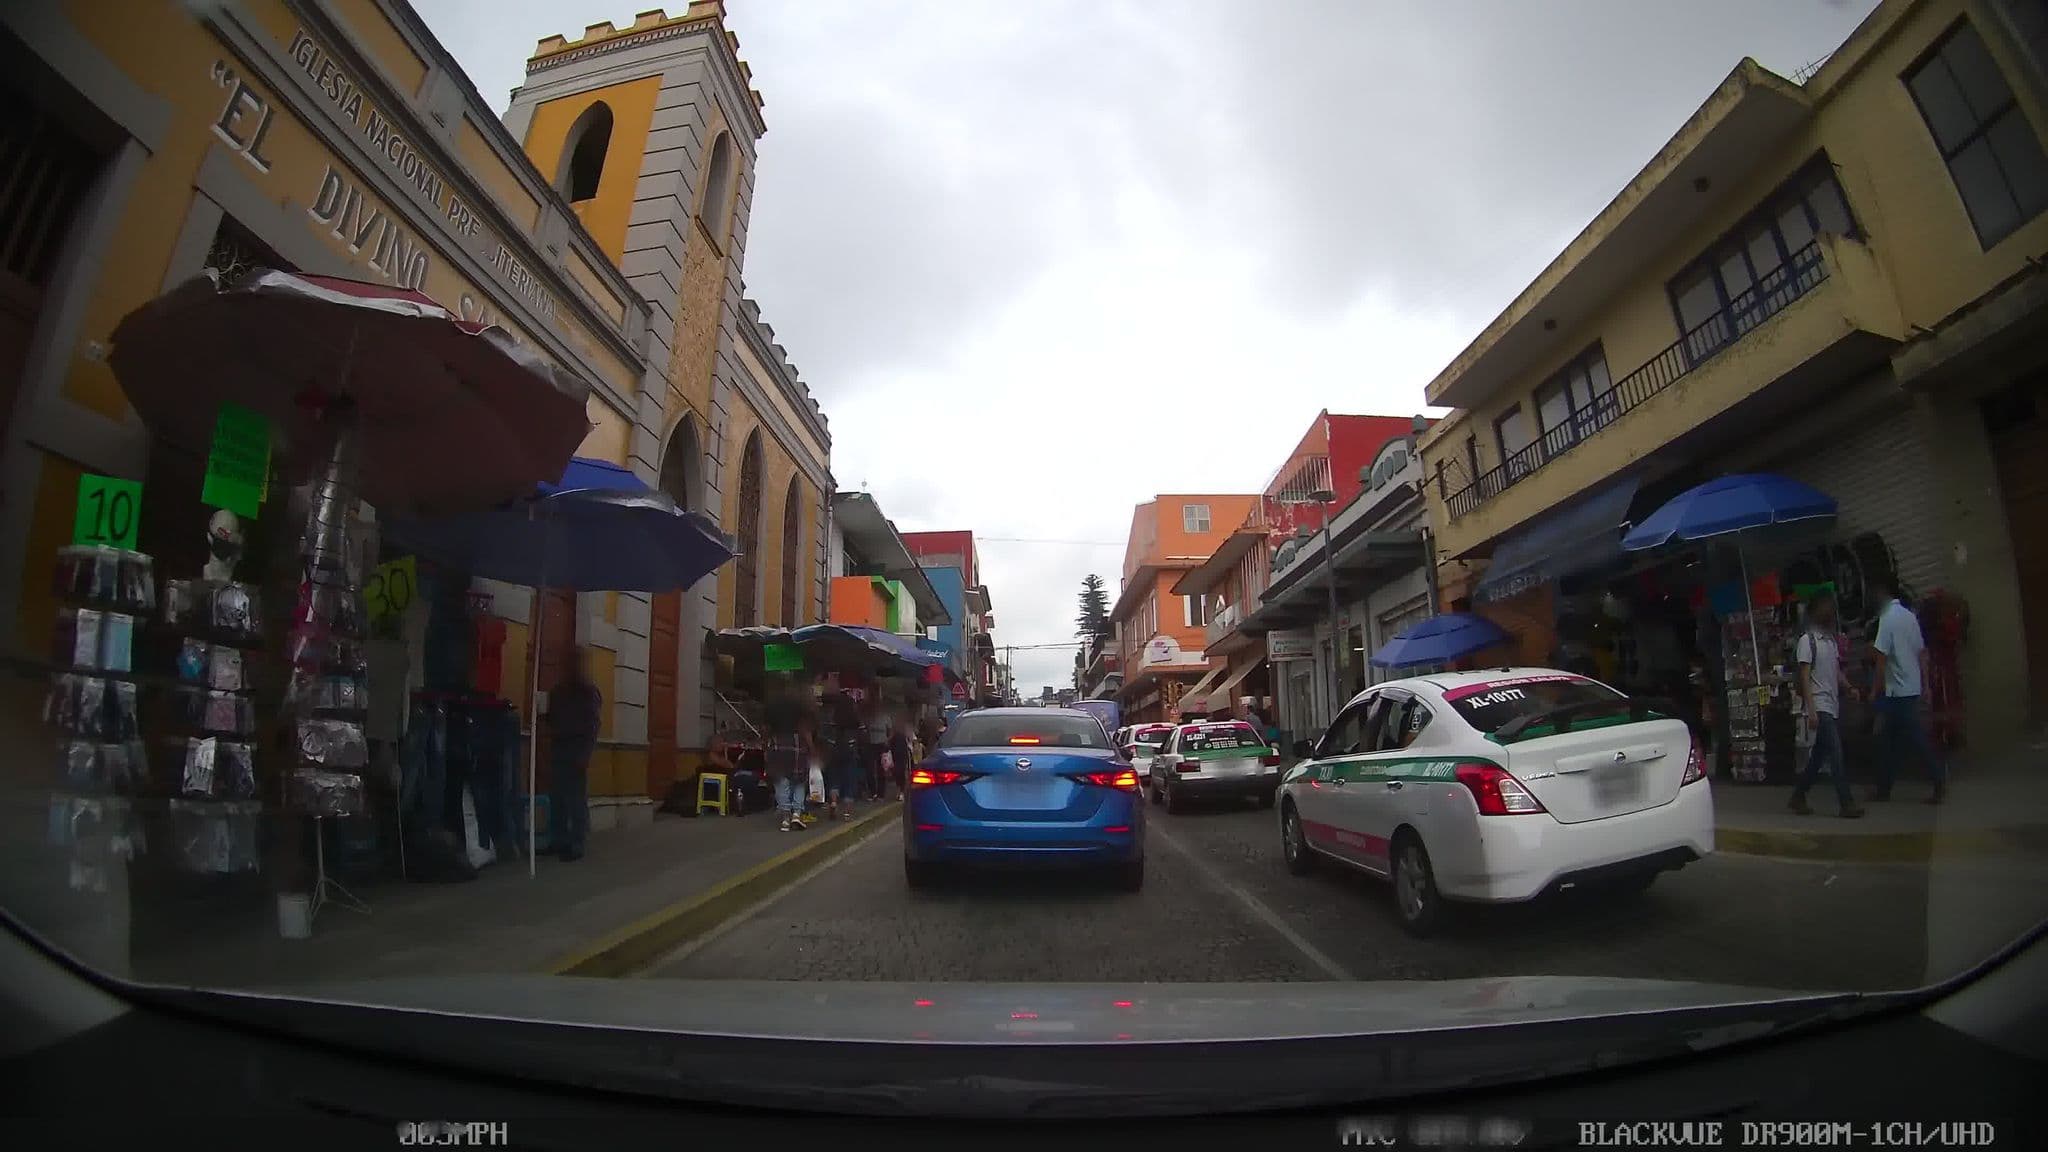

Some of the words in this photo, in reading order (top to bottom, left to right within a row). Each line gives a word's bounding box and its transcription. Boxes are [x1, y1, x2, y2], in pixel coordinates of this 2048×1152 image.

[289, 29, 363, 125] IGLESIA
[364, 108, 445, 211] NACIONAL
[307, 163, 430, 290] DIVINO
[84, 487, 133, 540] 10
[1465, 688, 1526, 709] XL-10177
